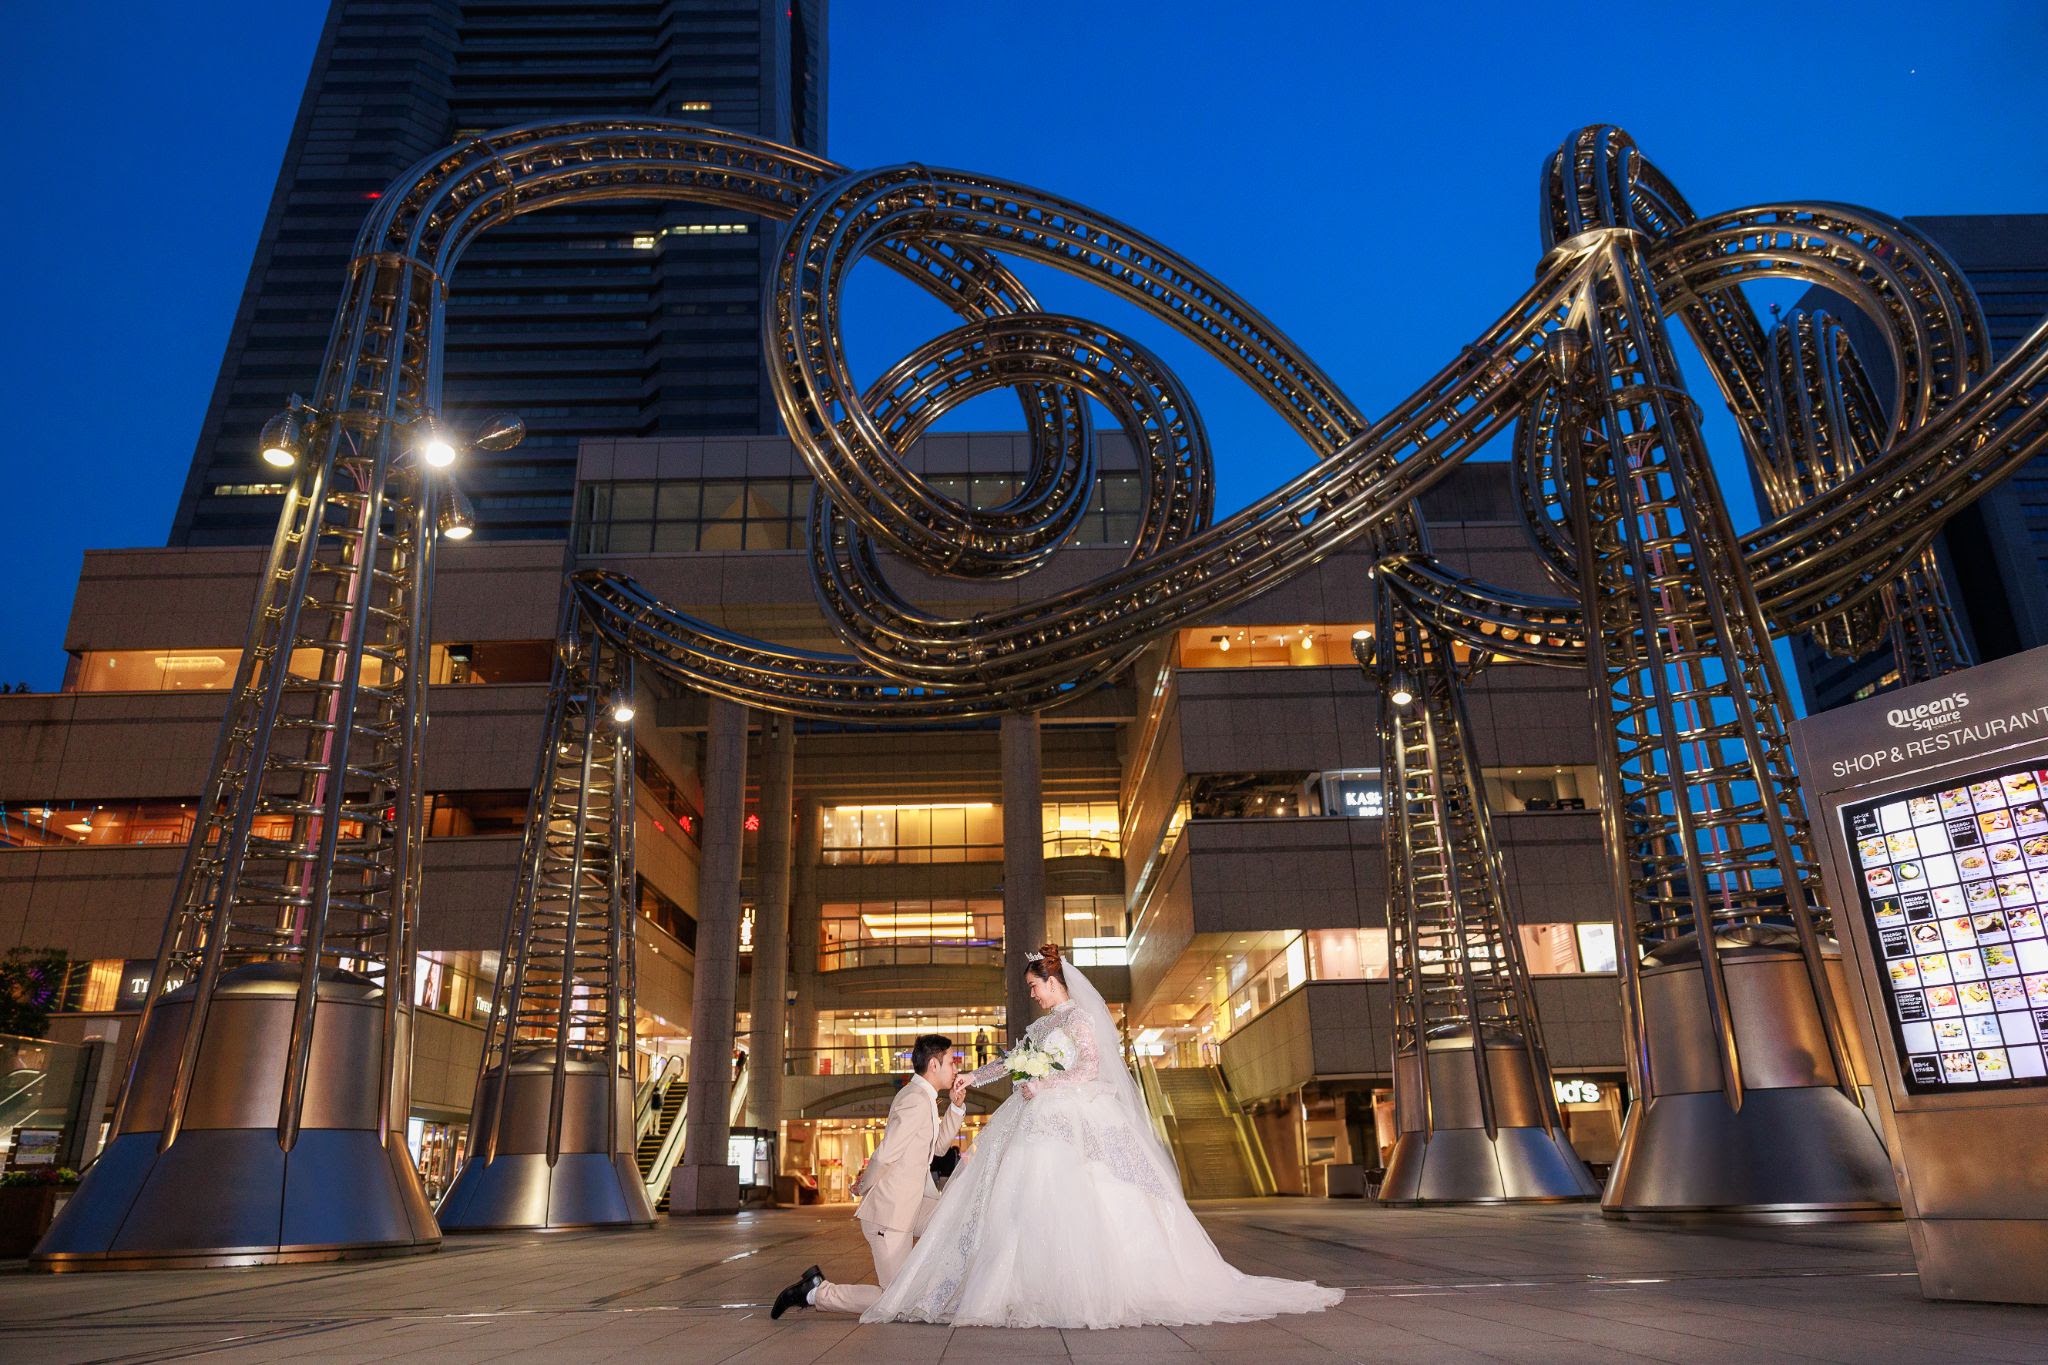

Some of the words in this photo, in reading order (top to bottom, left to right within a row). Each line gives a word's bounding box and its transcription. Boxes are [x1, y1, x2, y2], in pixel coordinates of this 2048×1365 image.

[1887, 692, 1970, 728] Queen's
[1832, 750, 1887, 777] SHOP
[1890, 746, 1905, 762] &
